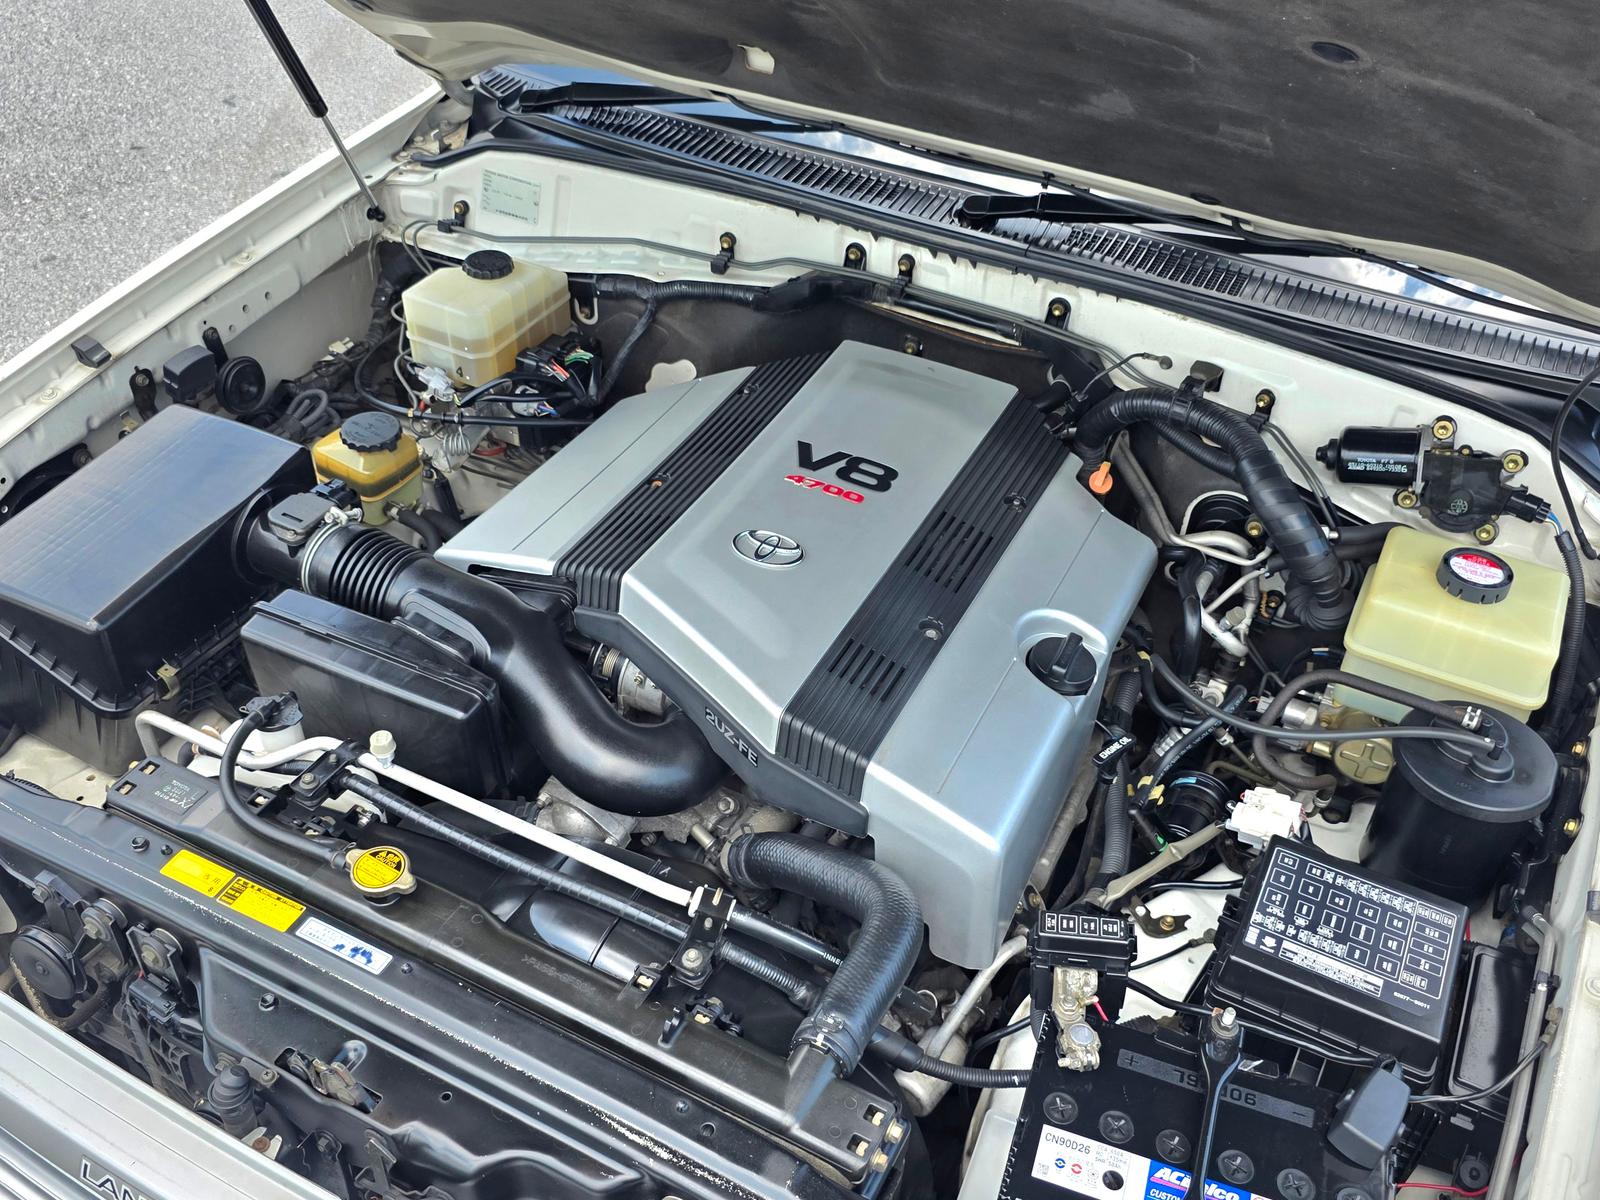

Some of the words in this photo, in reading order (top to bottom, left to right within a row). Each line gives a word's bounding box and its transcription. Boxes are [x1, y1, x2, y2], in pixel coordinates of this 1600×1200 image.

[797, 440, 899, 492] V8
[784, 474, 865, 504] 4700
[705, 708, 758, 767] 2UZ-FE
[1098, 741, 1123, 759] ENGINE
[1119, 736, 1133, 745] OIL
[1045, 1132, 1091, 1155] CN90D26
